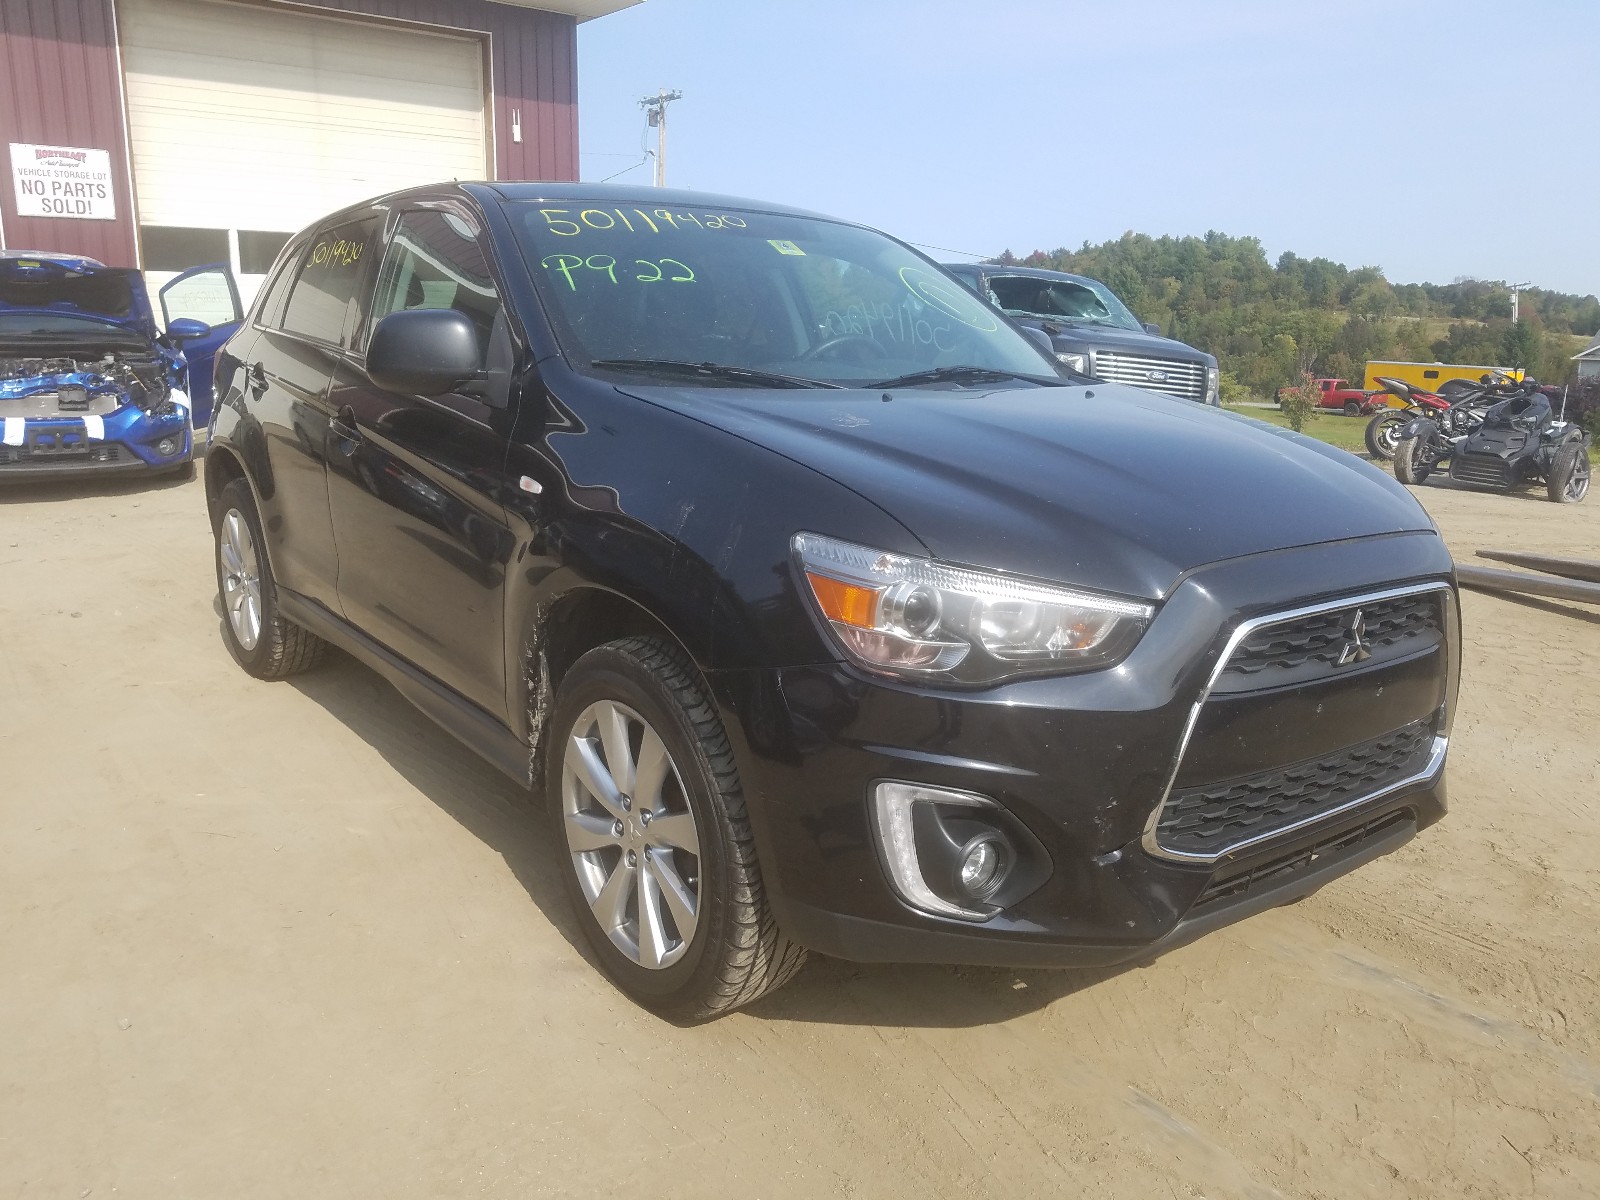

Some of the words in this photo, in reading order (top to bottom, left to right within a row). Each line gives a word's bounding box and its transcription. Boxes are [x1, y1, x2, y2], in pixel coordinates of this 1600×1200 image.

[18, 168, 51, 177] VEHICLE
[54, 170, 90, 180] STORAGE
[93, 172, 107, 181] LOT
[21, 179, 46, 196] NO
[52, 181, 107, 199] PARTS
[42, 198, 92, 215] SOLD!
[539, 208, 747, 236] 50119420
